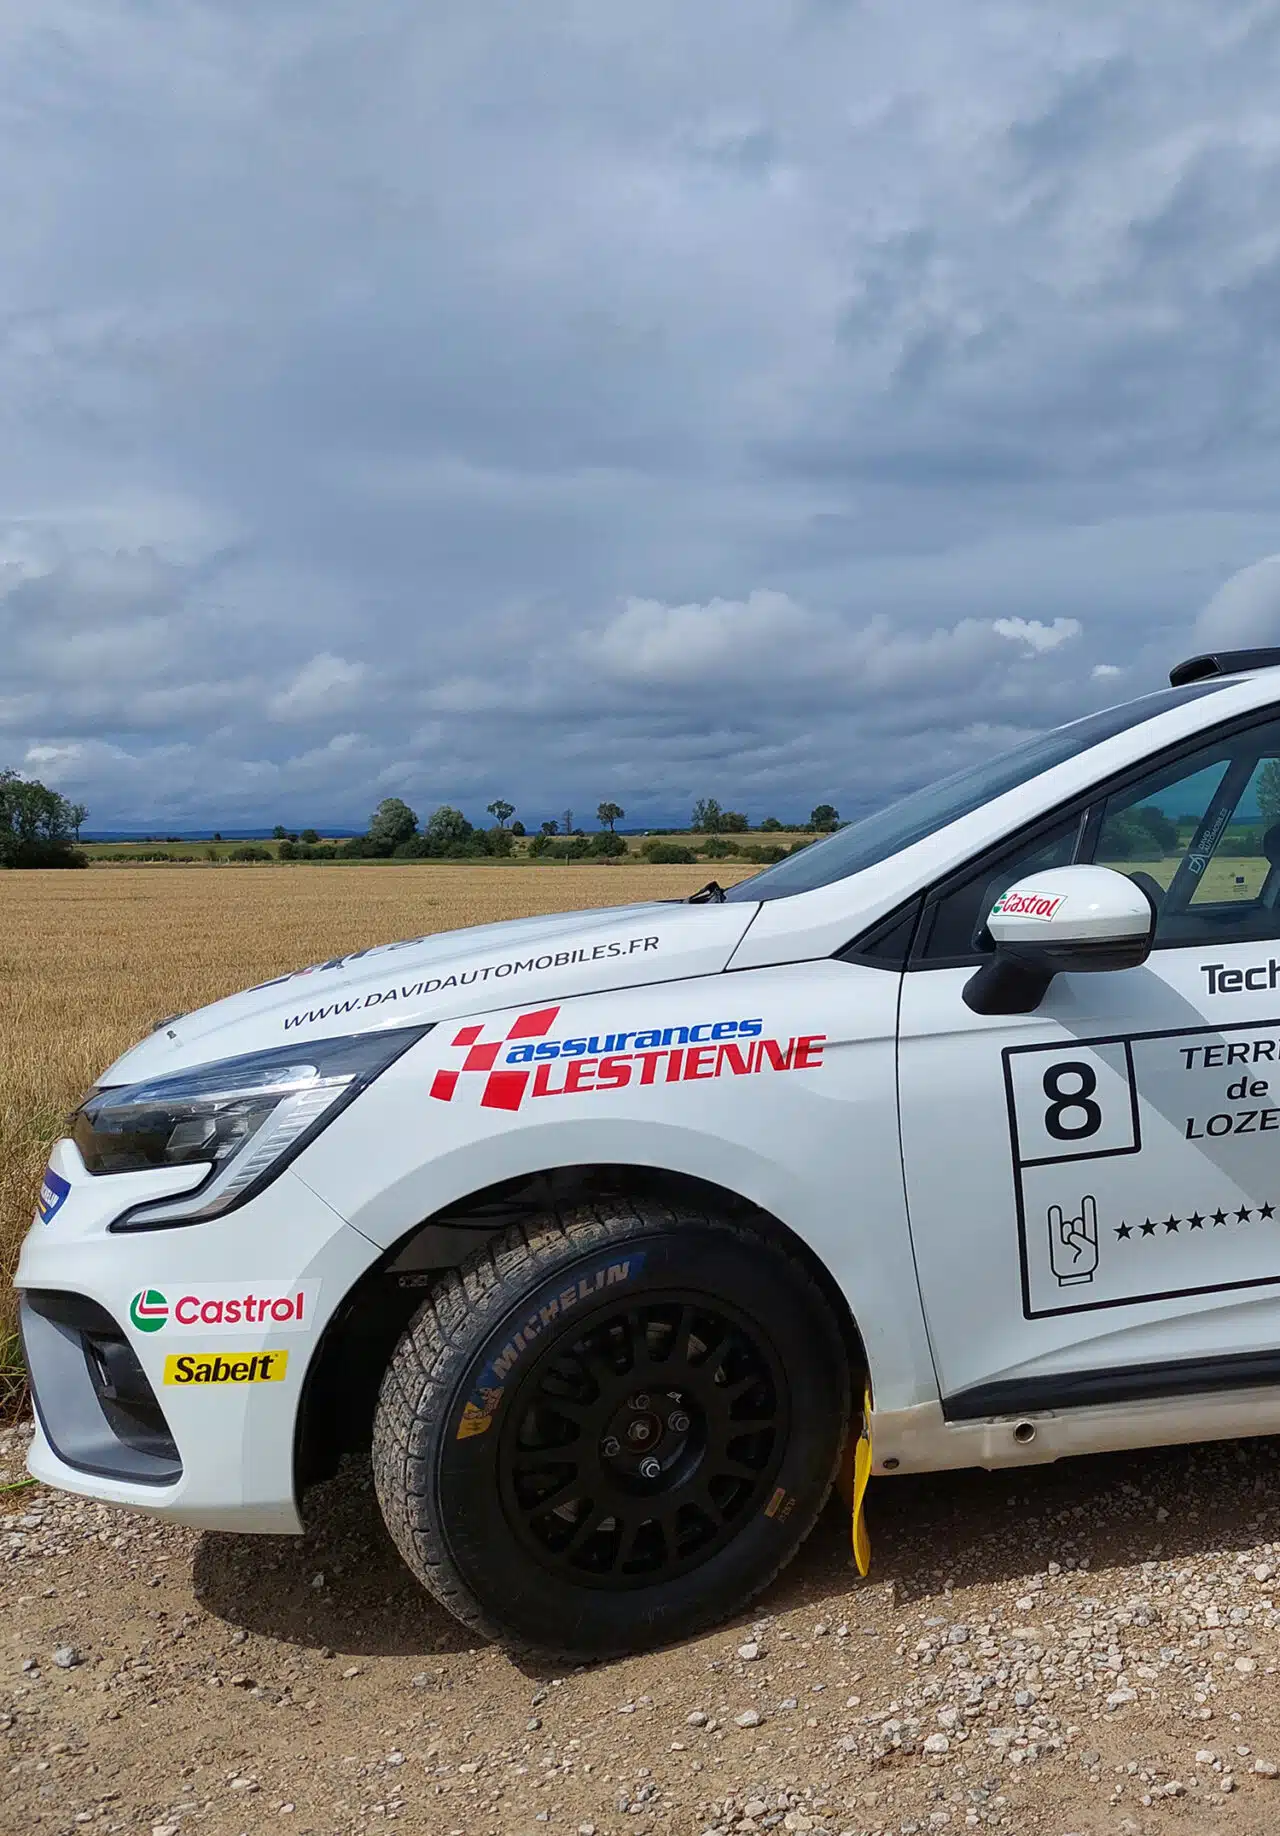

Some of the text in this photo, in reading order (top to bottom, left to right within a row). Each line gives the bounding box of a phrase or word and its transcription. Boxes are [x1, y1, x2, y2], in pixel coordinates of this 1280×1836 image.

[1002, 893, 1060, 917] Castrol
[284, 935, 660, 1030] WWW.DAVIDAUTOMOBILES.FR
[505, 1018, 763, 1064] assurances
[531, 1035, 827, 1098] LESTIENNE
[1226, 1076, 1269, 1100] de
[1042, 1061, 1102, 1141] 8
[175, 1292, 303, 1324] Castrol
[492, 1260, 630, 1380] MICHELIN
[175, 1355, 274, 1383] Sabelt
